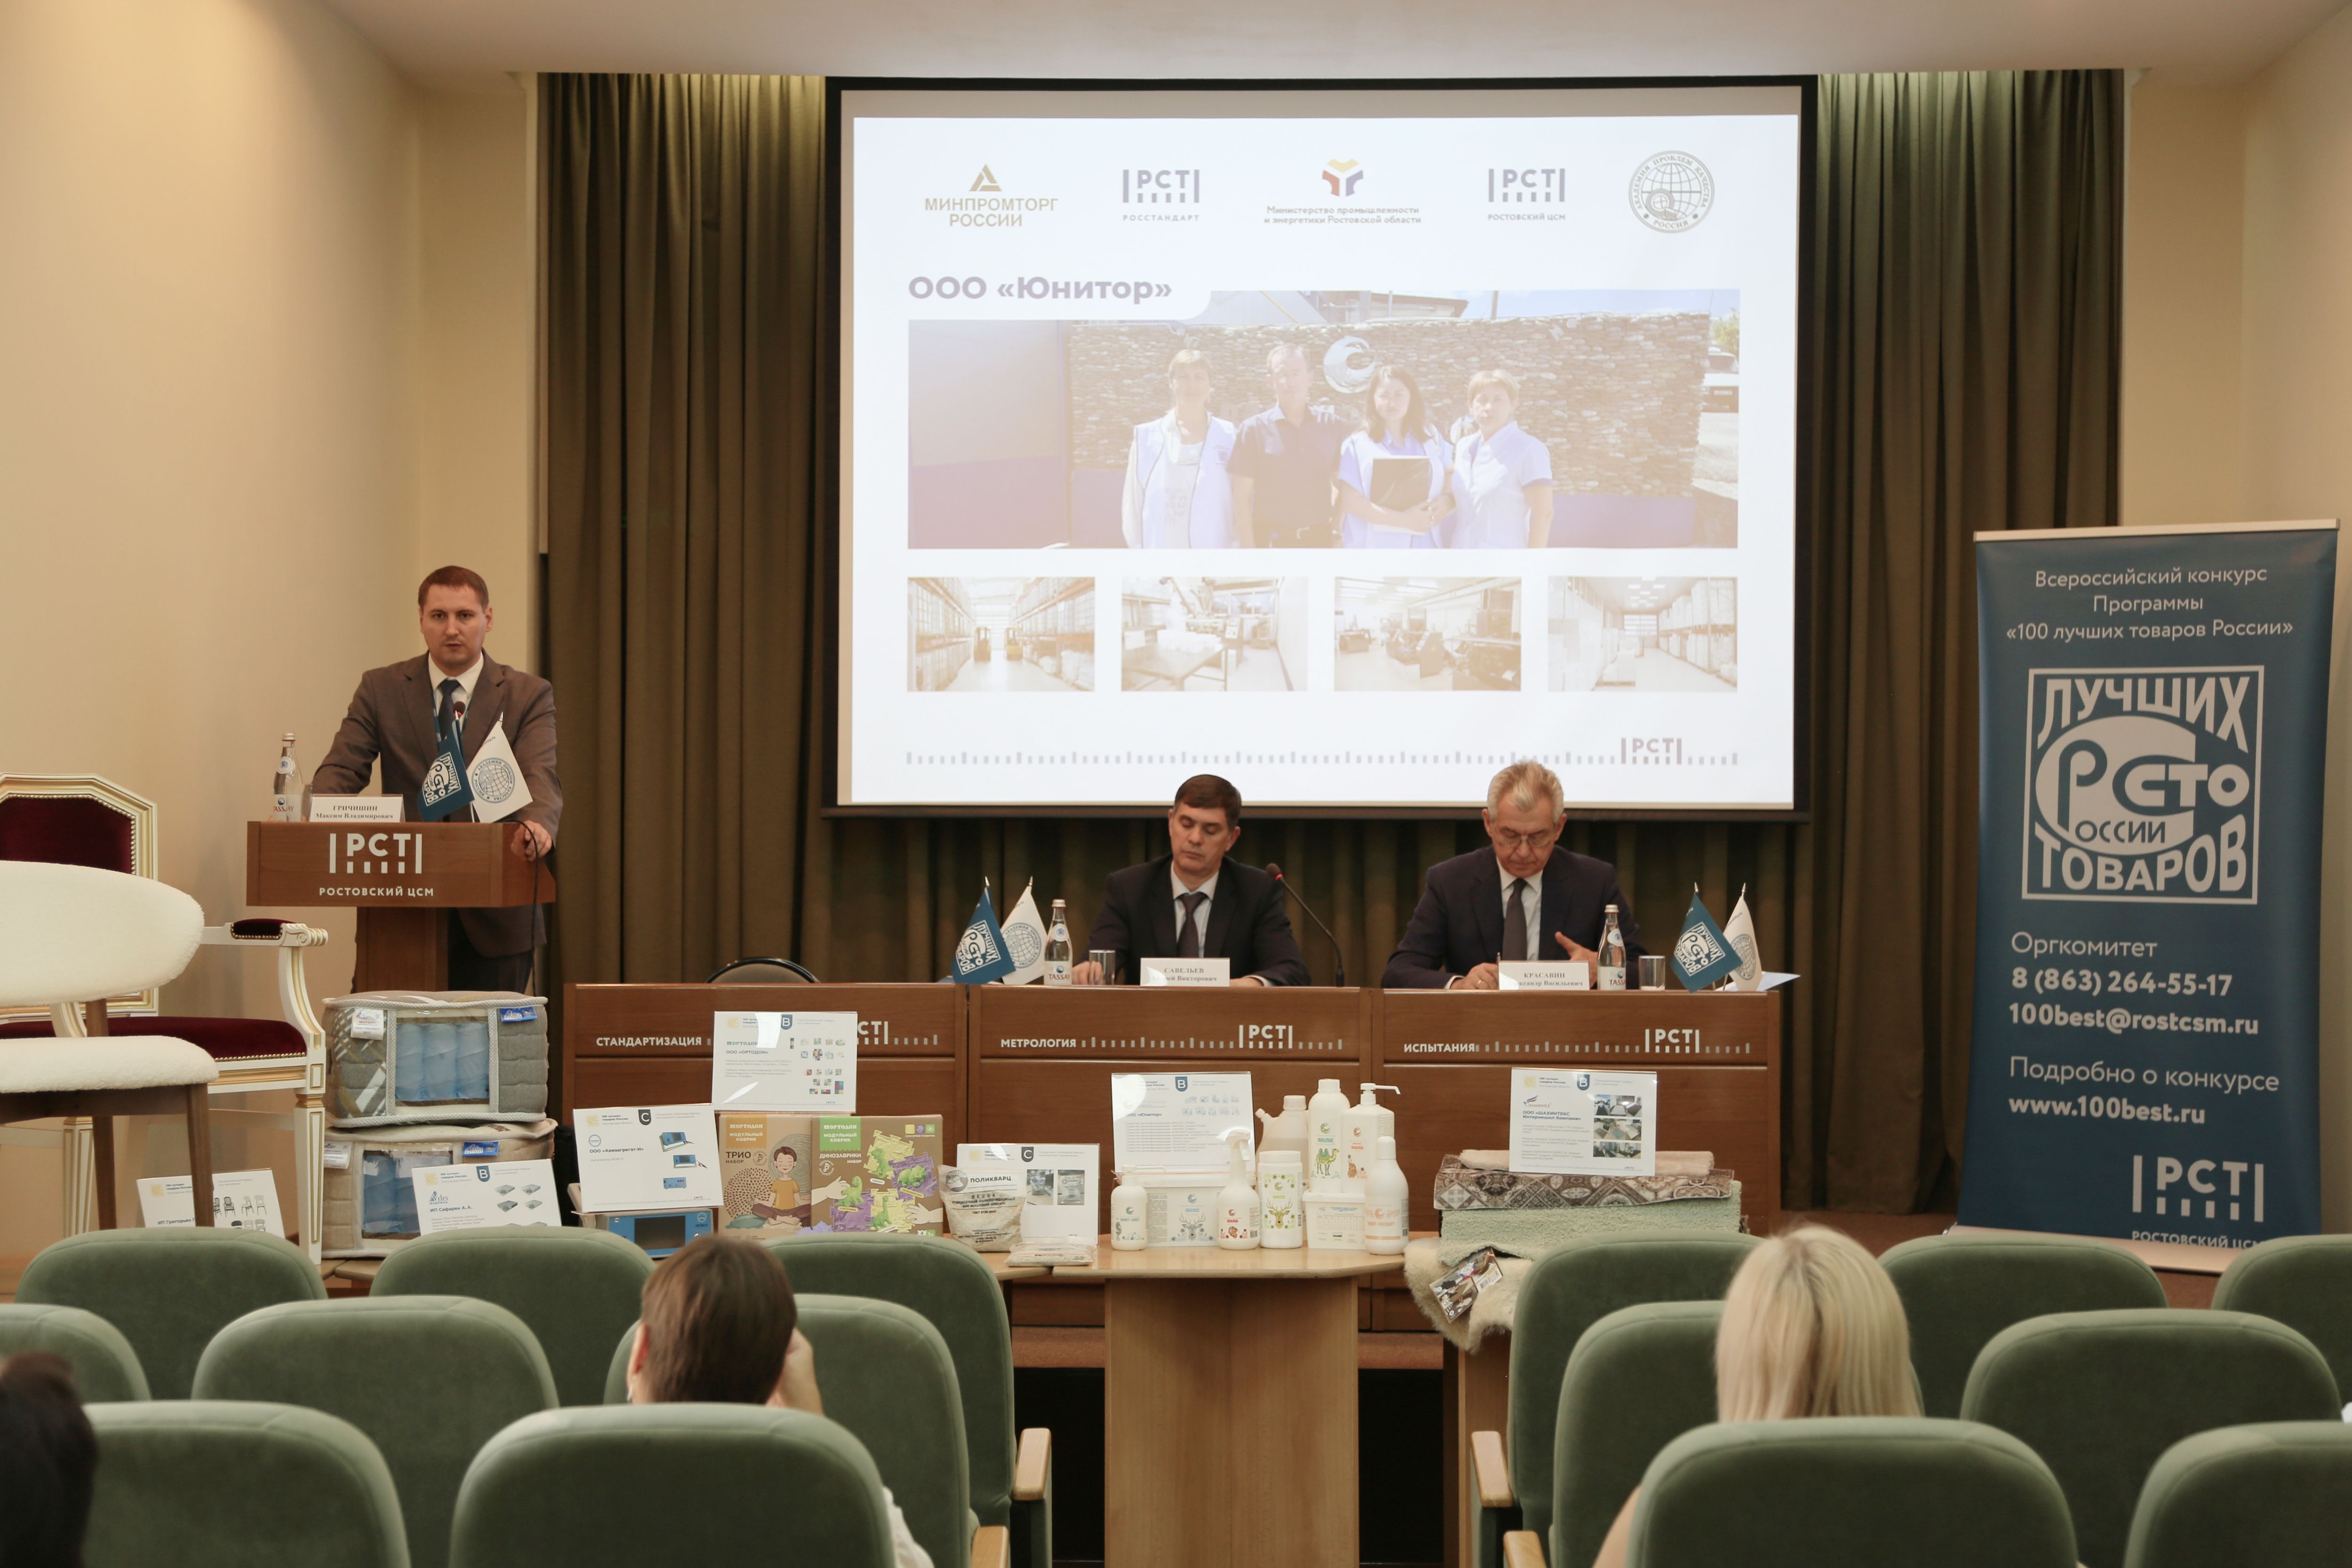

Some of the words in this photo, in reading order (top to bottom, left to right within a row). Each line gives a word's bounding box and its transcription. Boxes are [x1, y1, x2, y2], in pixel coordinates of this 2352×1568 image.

[925, 198, 1059, 211] МИНПРОМТОРГ
[1266, 206, 1335, 215] Министерство
[949, 213, 1023, 227] РОССИИ
[908, 276, 987, 299] ООО
[997, 276, 1172, 305] «Юнитор»
[2035, 567, 2182, 590] Всероссийский
[2187, 567, 2267, 585] конкурс
[2093, 594, 2204, 615] Программы
[2006, 623, 2049, 640] «100
[2053, 626, 2124, 643] лучших
[2129, 625, 2206, 642] товаров
[2212, 619, 2294, 637] России»
[2037, 676, 2250, 754] ЛУЧШИХ
[2034, 813, 2247, 894] ТОВАРОВ
[319, 886, 404, 897] РОСТОВСКИЙ
[407, 888, 434, 898] ЦСМ
[1691, 924, 1723, 962] ЛУЧШИХ
[2011, 931, 2158, 959] Оргкомитет
[2011, 967, 2027, 989] 8
[2034, 968, 2102, 996] (863)
[2107, 970, 2233, 997] 264-55-17
[2009, 1002, 2259, 1035] 100best@rostcsm.ru
[596, 1037, 702, 1047] СТАНДАРТИЗАЦИЯ
[1001, 1038, 1076, 1048] МЕТРОЛОГИЯ
[1404, 1043, 1475, 1053] ИСПЫТАНИЯ
[2010, 1056, 2136, 1085] Подробно
[2142, 1072, 2158, 1085] о
[2165, 1070, 2280, 1095] конкурсе
[2009, 1096, 2206, 1124] www.100best.ru
[2131, 1230, 2228, 1248] РОСТОВСКИЙ
